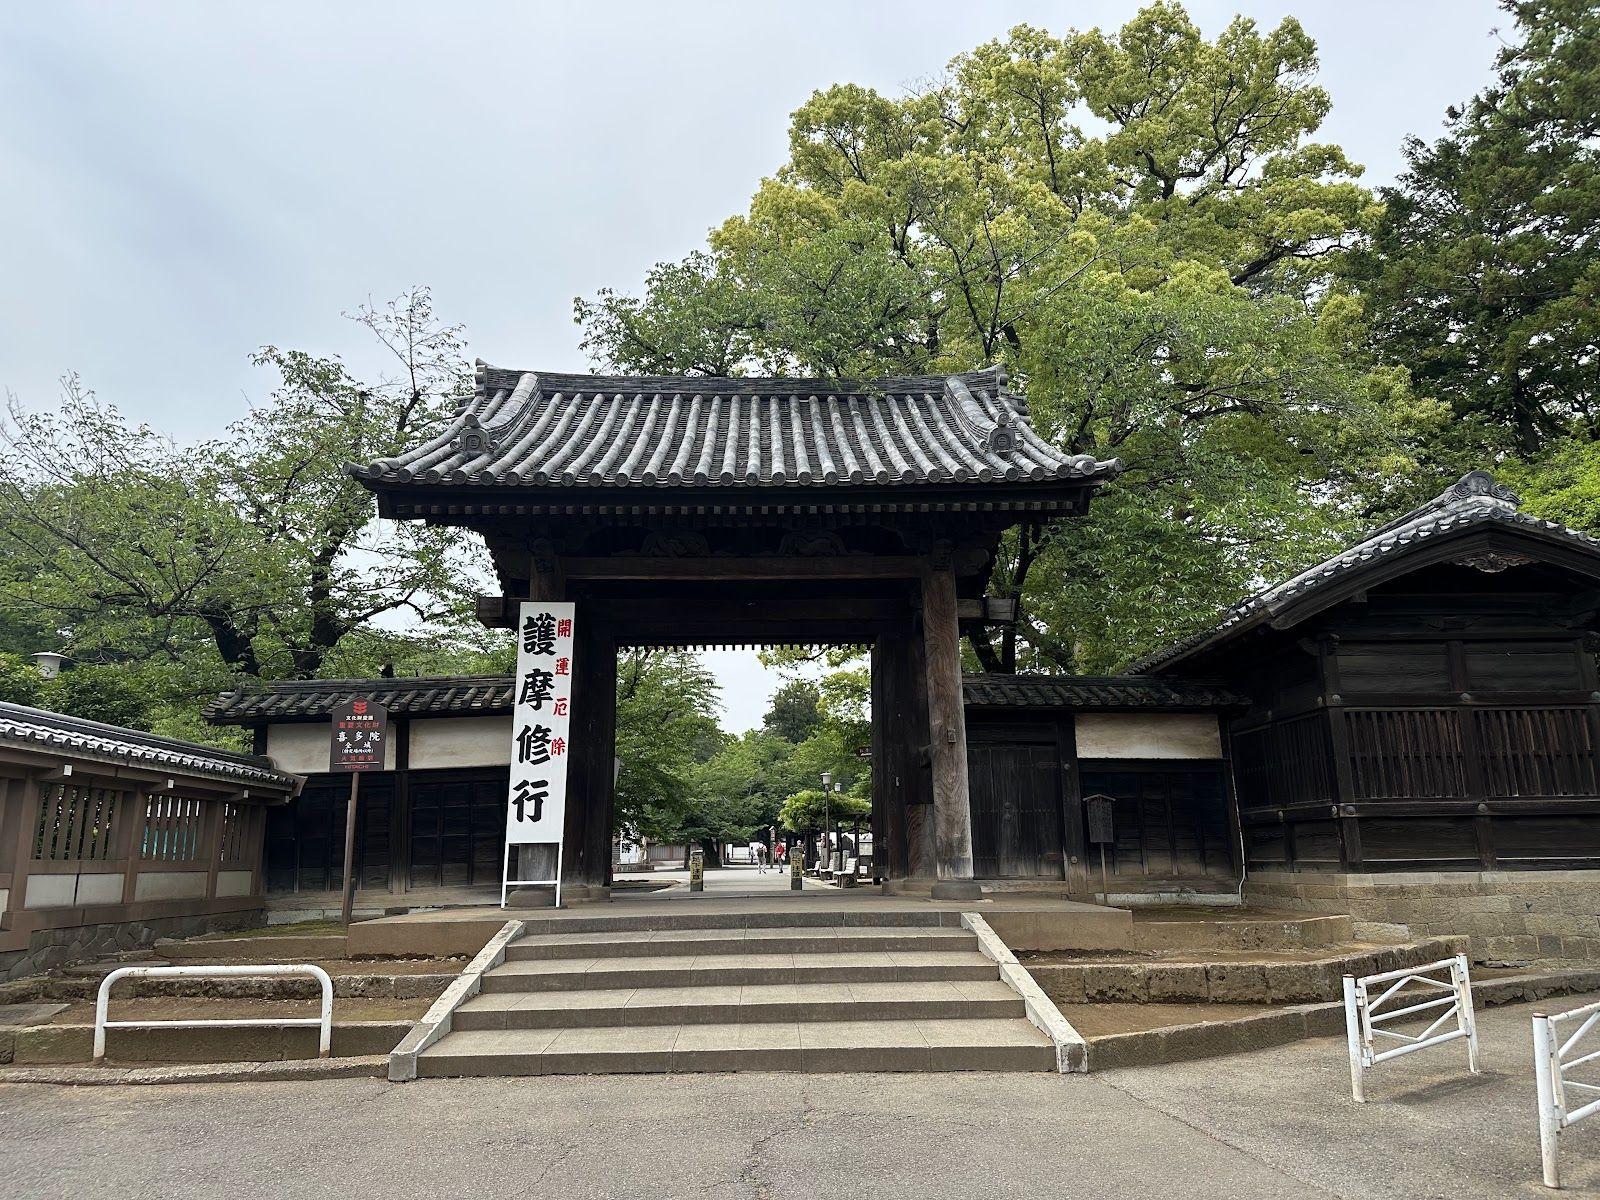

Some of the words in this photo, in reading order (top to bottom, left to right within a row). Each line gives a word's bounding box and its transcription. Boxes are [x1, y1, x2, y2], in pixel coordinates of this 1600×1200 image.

[336, 730, 381, 742] 喜多院
[511, 612, 557, 823] 護摩修行
[551, 618, 572, 756] 開運厄除
